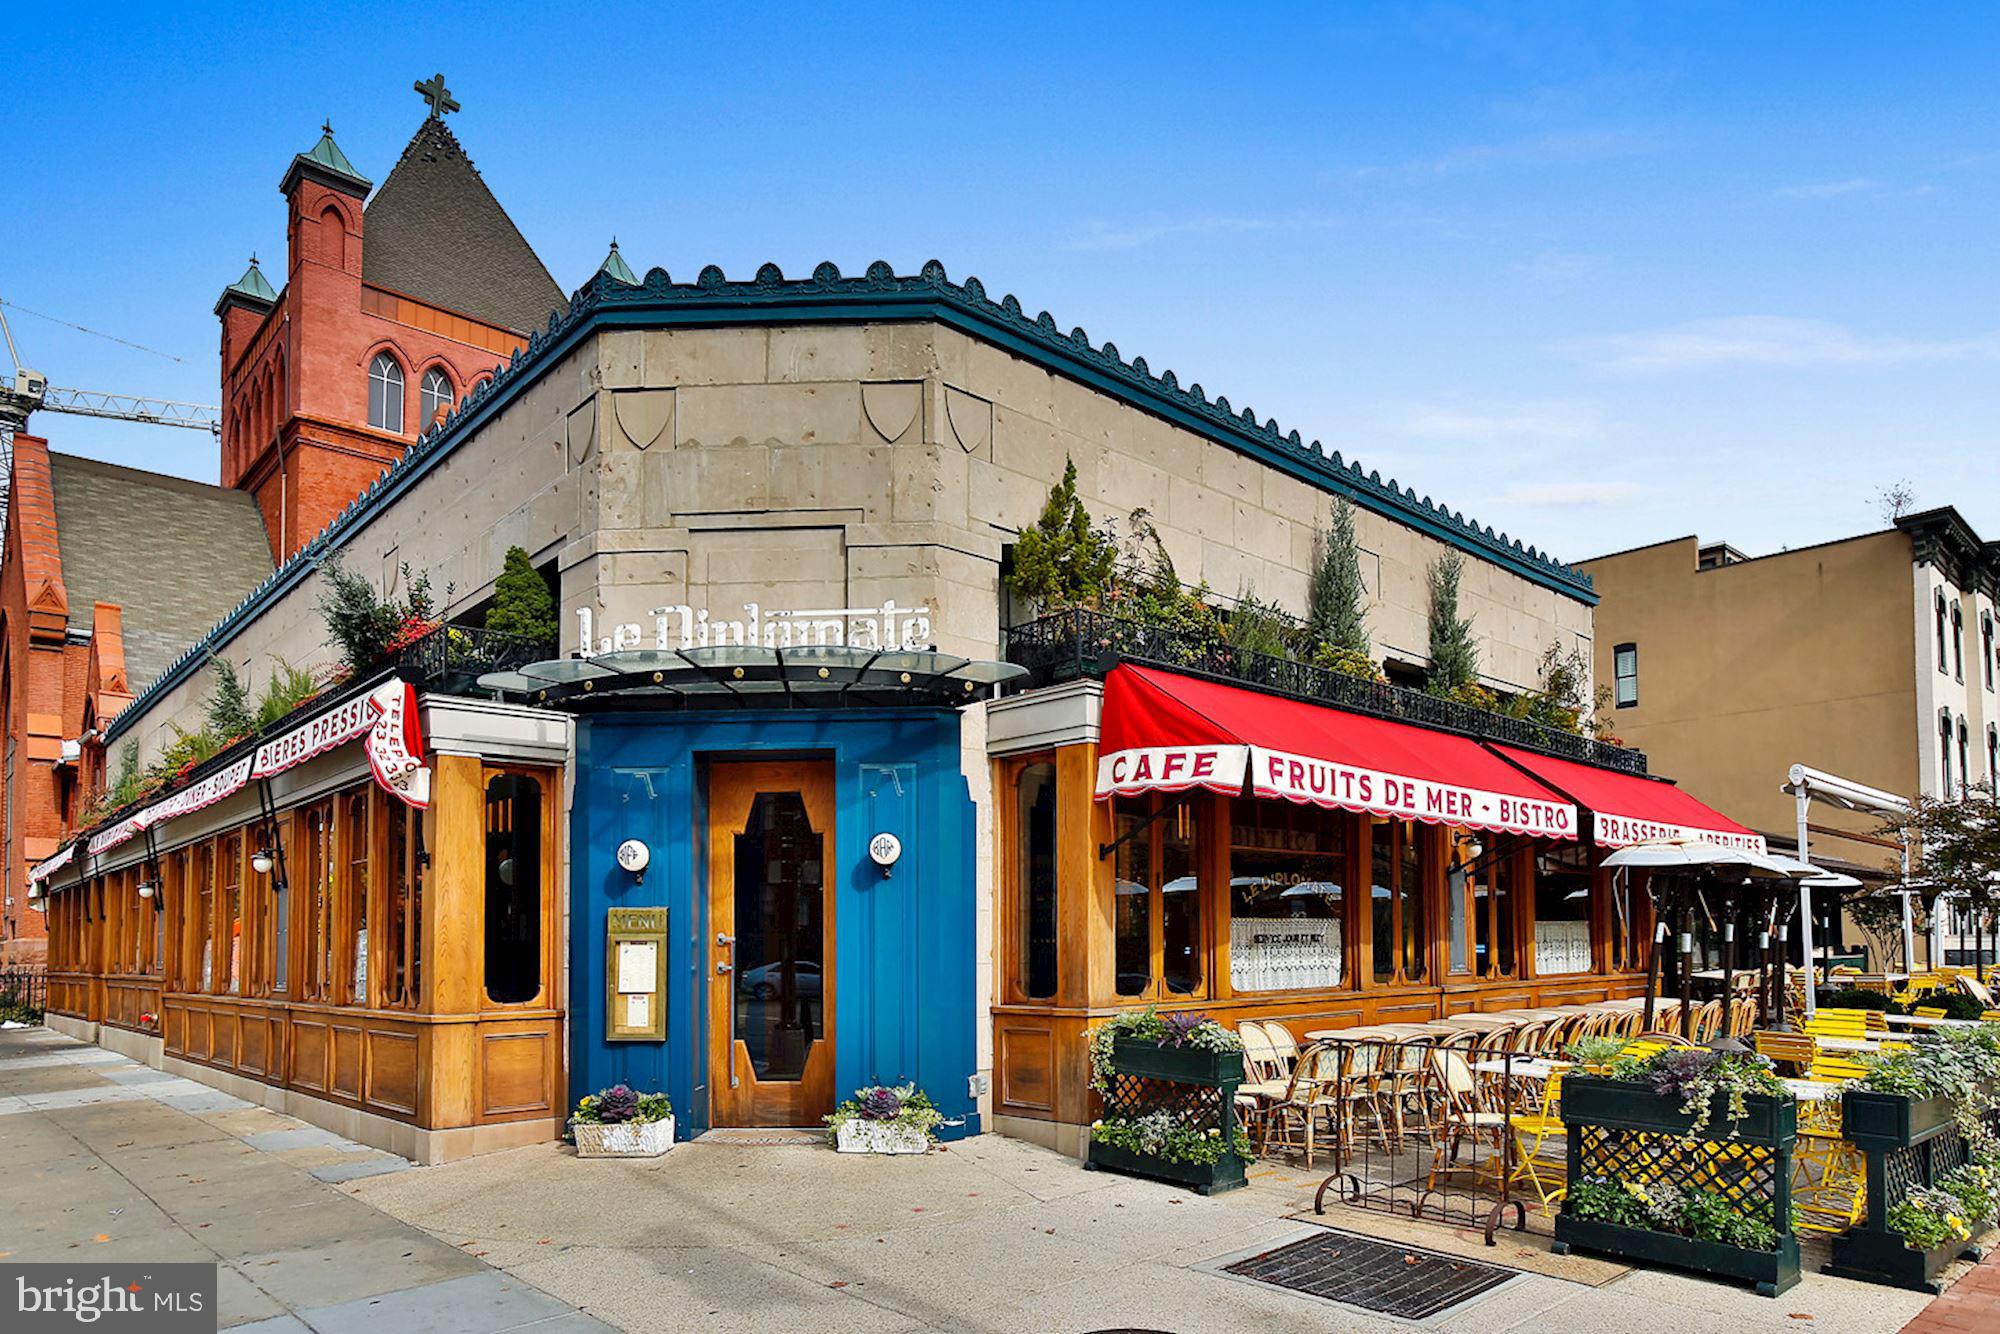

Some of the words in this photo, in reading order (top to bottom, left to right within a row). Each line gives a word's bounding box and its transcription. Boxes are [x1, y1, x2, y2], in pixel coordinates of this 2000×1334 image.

[576, 606, 641, 658] Le
[648, 599, 930, 652] Diplomate
[260, 731, 306, 768] BIERES
[1112, 751, 1218, 784] CAFE
[1268, 755, 1373, 802] FRUITS
[1384, 779, 1416, 809] DE
[1426, 786, 1473, 818] MER
[1500, 798, 1569, 830] BISTRO
[612, 912, 663, 930] MENU
